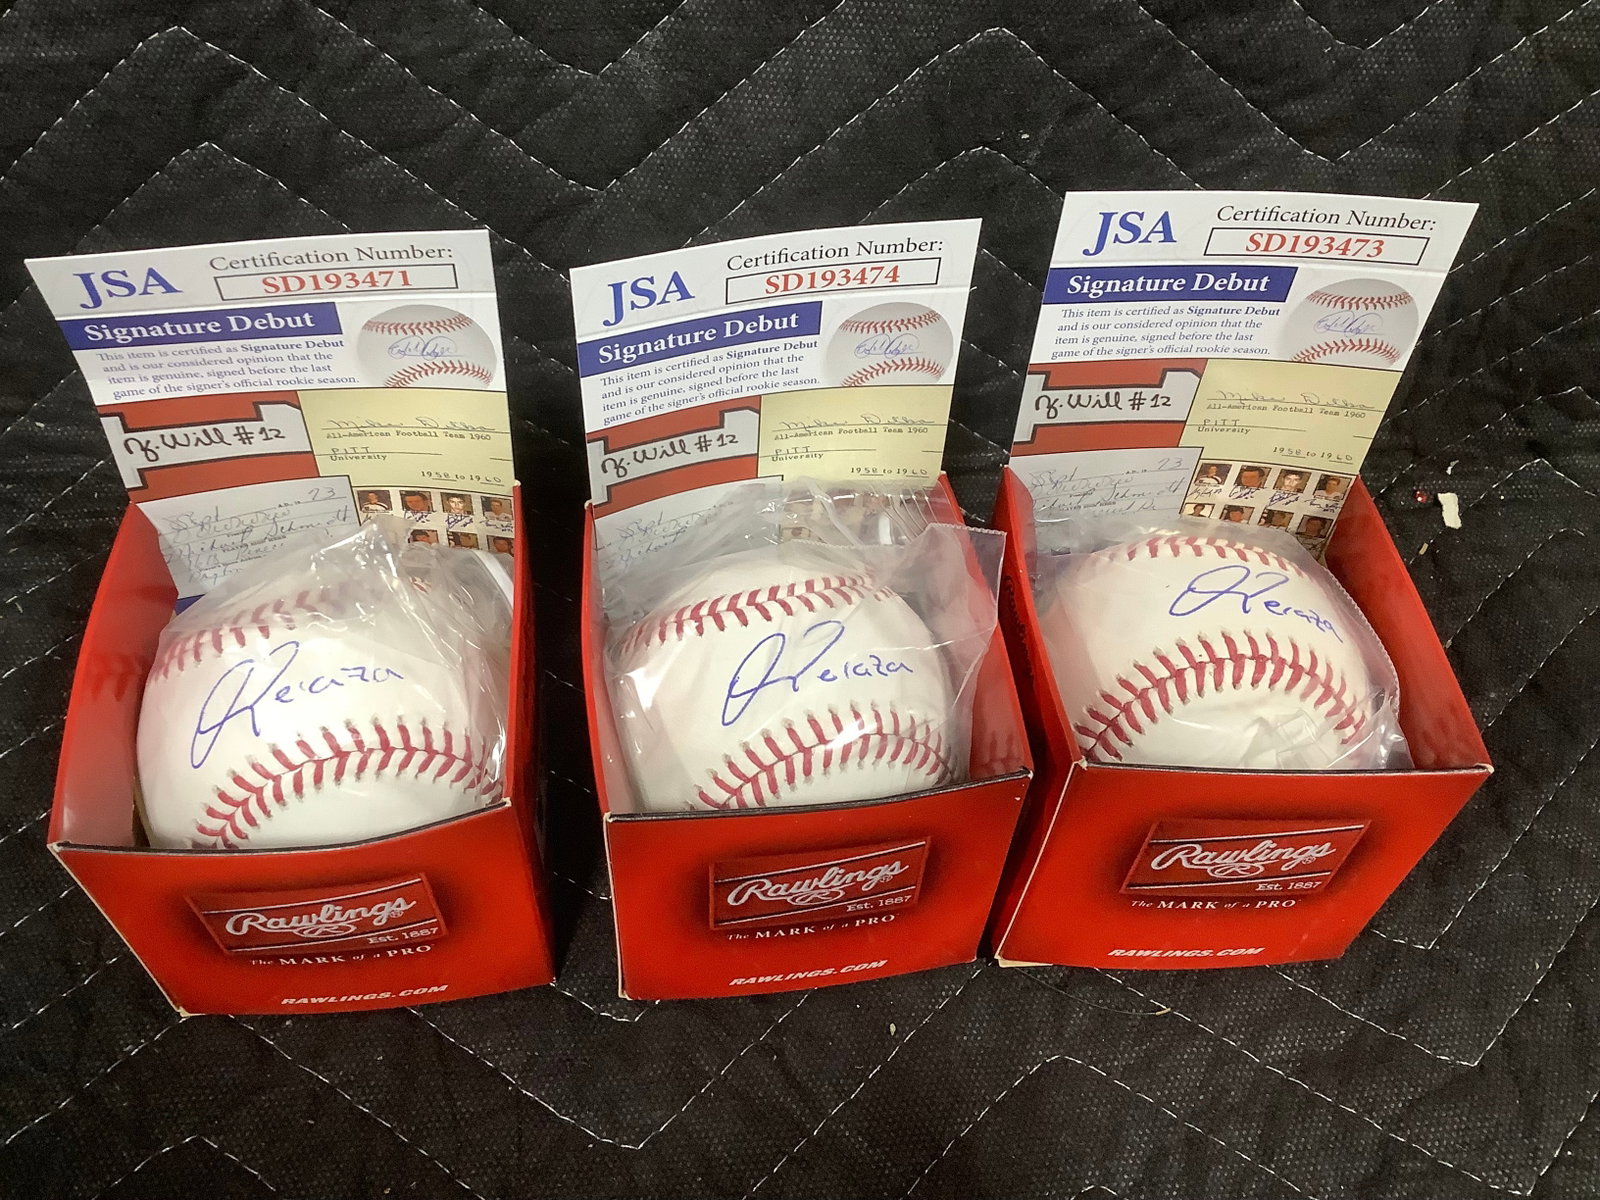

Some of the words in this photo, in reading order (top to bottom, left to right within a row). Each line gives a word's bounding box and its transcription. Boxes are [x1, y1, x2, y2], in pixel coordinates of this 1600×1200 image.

[1217, 205, 1340, 224] Certification
[1346, 207, 1437, 231] Number:
[1082, 210, 1177, 257] JSA
[1245, 232, 1385, 258] SD193473
[209, 250, 348, 270] Certification
[357, 245, 453, 261] Number:
[727, 244, 849, 271] Certification
[856, 238, 943, 256] Number:
[73, 267, 182, 309] JSA
[261, 270, 413, 294] SD193471
[765, 265, 900, 294] SD193474
[1067, 274, 1186, 299] Signature
[1191, 272, 1270, 292] Debut
[602, 270, 695, 327] JSA
[1061, 308, 1084, 318] This
[1087, 308, 1111, 317] item
[1114, 308, 1123, 316] is
[1125, 305, 1171, 316] certified
[1187, 305, 1242, 316] Signature
[1244, 306, 1280, 316] Debut
[84, 320, 221, 343] Signature
[227, 312, 315, 332] Debut
[1057, 322, 1078, 331] and
[1081, 322, 1089, 331] is
[1114, 319, 1173, 329] considered
[1175, 320, 1217, 330] opinion
[1221, 319, 1242, 328] that
[1244, 319, 1262, 328] the
[599, 327, 716, 364] Signature
[724, 312, 799, 338] Debut
[1055, 336, 1078, 344] item
[1081, 335, 1090, 344] is
[1092, 333, 1138, 345] genuine,
[1141, 332, 1176, 343] signed
[1178, 331, 1212, 340] before
[1215, 332, 1232, 340] the
[1234, 332, 1253, 341] last
[96, 353, 124, 361] This
[128, 351, 155, 359] item
[171, 345, 222, 356] certified
[241, 343, 302, 353] Signature
[306, 340, 344, 349] Debut
[103, 364, 126, 372] and
[142, 362, 163, 370] our
[167, 357, 233, 368] considered
[236, 354, 283, 365] opinion
[287, 353, 311, 361] that
[314, 352, 333, 360] the
[1051, 350, 1080, 360] game
[1083, 347, 1095, 356] of
[1096, 347, 1113, 355] the
[1115, 345, 1154, 357] signer's
[1157, 345, 1193, 353] official
[1195, 345, 1230, 353] rookie
[1232, 347, 1271, 355] season.
[108, 376, 135, 384] item
[152, 371, 204, 383] genuine,
[207, 367, 245, 379] signed
[248, 367, 286, 375] before
[289, 365, 308, 373] the
[311, 364, 332, 372] last
[600, 375, 624, 386] This
[627, 371, 651, 380] item
[654, 367, 663, 375] is
[665, 355, 710, 372] certified
[726, 345, 780, 360] Signature
[784, 340, 818, 351] Debut
[113, 388, 145, 400] game
[149, 385, 161, 394] of
[164, 384, 184, 392] the
[187, 380, 230, 392] signer's
[233, 378, 273, 388] official
[277, 376, 313, 386] rookie
[317, 376, 360, 384] season.
[601, 388, 622, 399] and
[625, 385, 634, 394] is
[636, 380, 655, 391] our
[658, 366, 716, 386] considered
[718, 360, 760, 374] opinion
[763, 356, 784, 366] that
[787, 354, 804, 363] the
[602, 400, 627, 412] item
[629, 397, 638, 405] is
[640, 387, 686, 404] genuine,
[688, 376, 723, 391] signed
[725, 371, 759, 384] before
[761, 369, 778, 378] the
[781, 367, 799, 375] last
[603, 412, 632, 426] game
[635, 405, 646, 416] of
[648, 402, 665, 412] the
[667, 393, 706, 408] signer's
[708, 385, 743, 399] official
[746, 381, 781, 392] rookie
[782, 377, 820, 387] season.
[1206, 403, 1267, 411] All-American
[1272, 404, 1313, 414] Football
[1319, 408, 1340, 417] Team
[1344, 410, 1366, 419] 1960
[326, 431, 391, 439] All-American
[396, 430, 438, 438] Football
[443, 431, 465, 439] Team
[470, 433, 491, 441] 1960
[774, 430, 833, 440] All-American
[838, 427, 878, 435] Football
[1197, 425, 1251, 434] University
[330, 453, 387, 462] University
[771, 452, 824, 462] University
[1151, 840, 1337, 875] Rawlings
[727, 860, 910, 905] Rawlings
[1255, 883, 1284, 891] Est.
[1287, 881, 1323, 890] 1887
[846, 902, 874, 912] Est.
[878, 895, 912, 907] 1887
[1157, 900, 1220, 909] MARK
[1224, 900, 1238, 908] of
[1255, 899, 1297, 909] PRO
[225, 897, 417, 936] Rawlings
[755, 925, 816, 939] MARK
[855, 914, 896, 927] PRO
[368, 935, 398, 944] Est.
[403, 927, 439, 940] 1887
[279, 955, 346, 965] MARK
[352, 953, 365, 961] of
[386, 944, 432, 957] PRO
[1108, 947, 1265, 958] RAWLINGS.COM
[728, 959, 888, 986] RAWLINGS.COM
[281, 984, 449, 1005] RAWLINGS.COM
